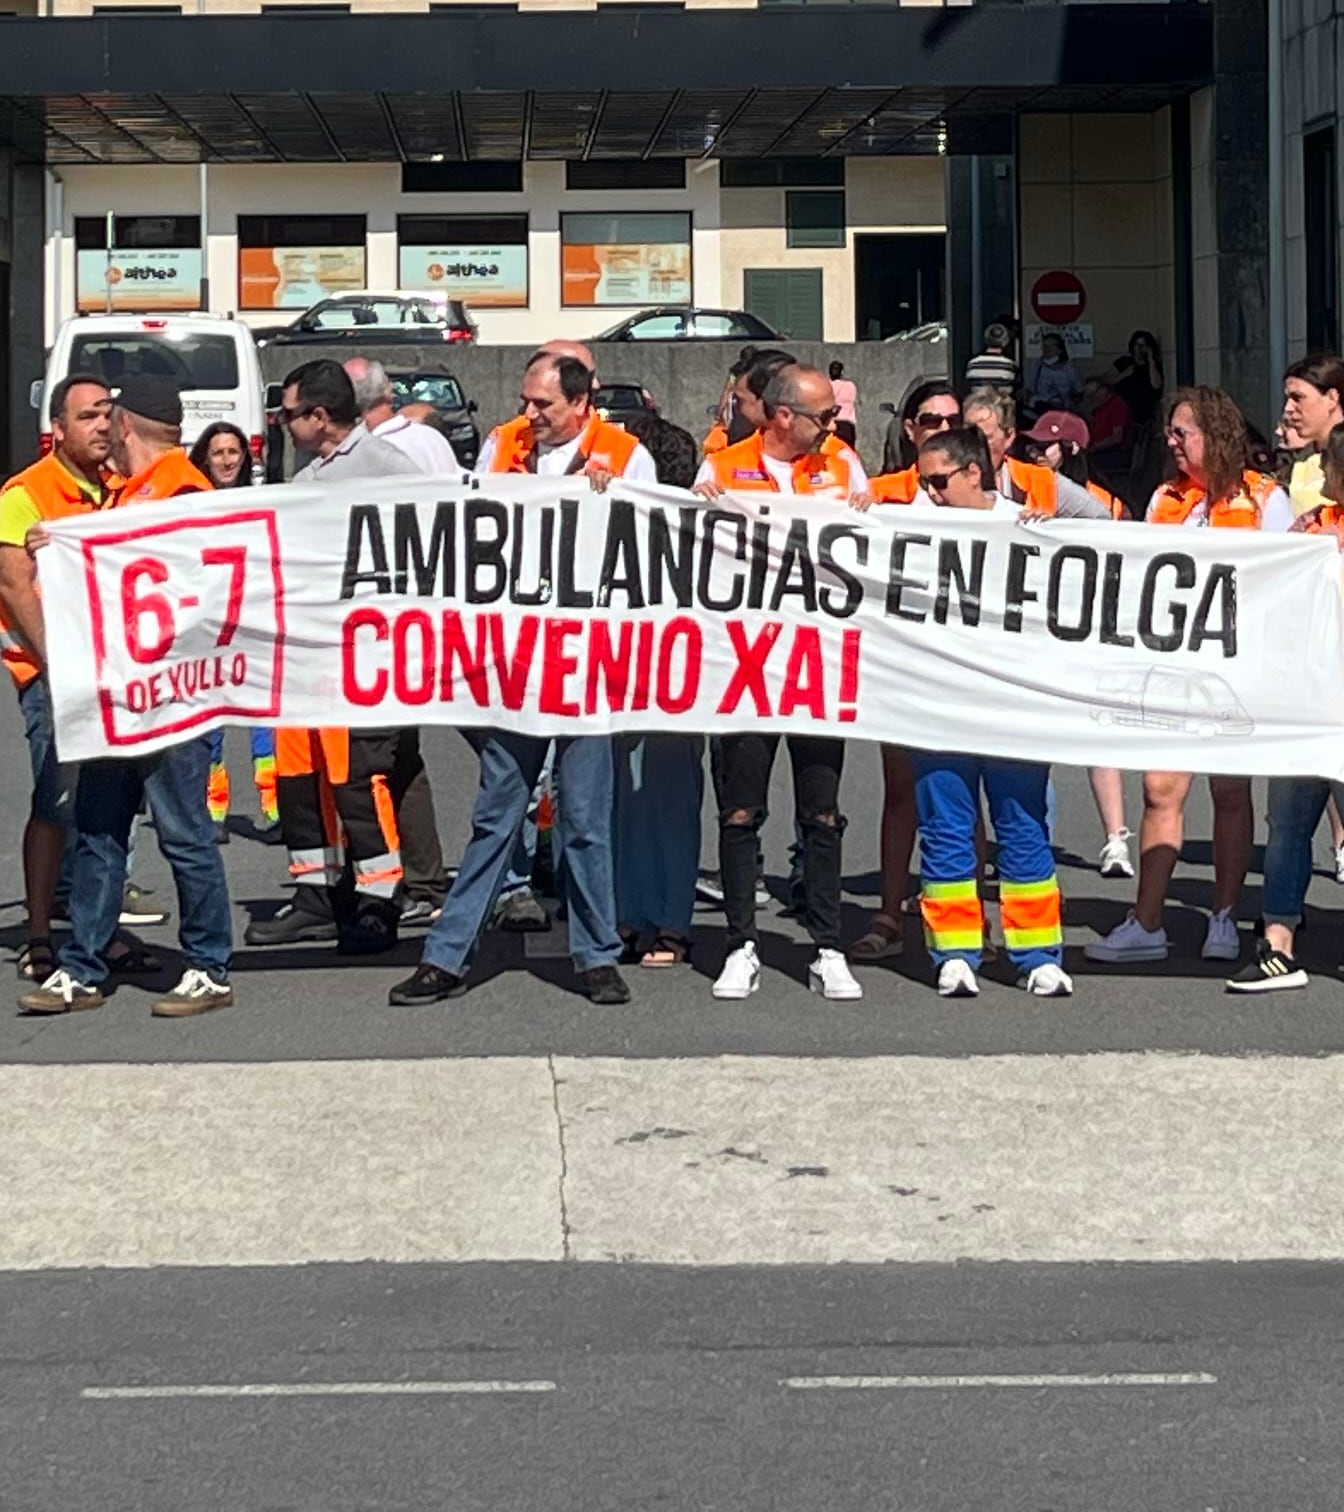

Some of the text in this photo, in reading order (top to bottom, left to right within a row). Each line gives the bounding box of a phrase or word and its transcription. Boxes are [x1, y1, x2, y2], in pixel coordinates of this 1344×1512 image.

[120, 545, 248, 664] 6-7
[884, 532, 987, 627] EN
[1003, 543, 1238, 659] FOLGA
[167, 652, 247, 704] XULLO
[340, 606, 862, 723] CONVENIO XA!
